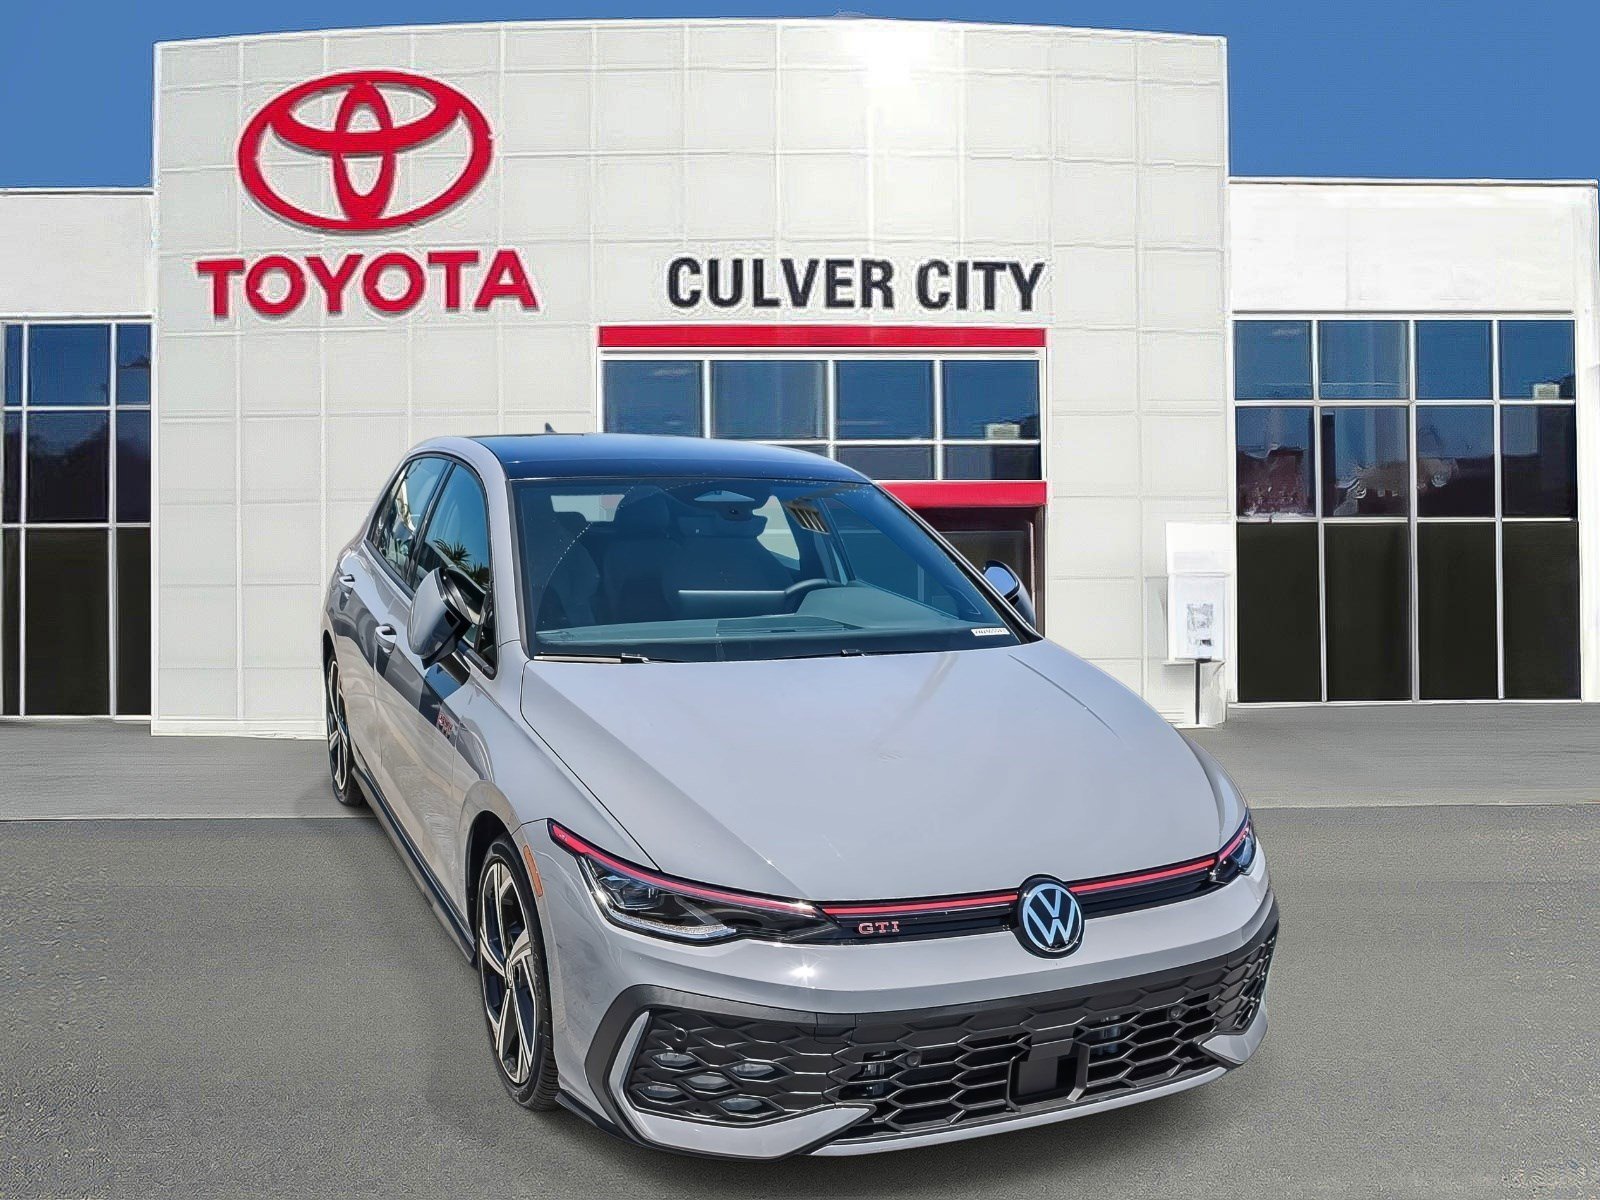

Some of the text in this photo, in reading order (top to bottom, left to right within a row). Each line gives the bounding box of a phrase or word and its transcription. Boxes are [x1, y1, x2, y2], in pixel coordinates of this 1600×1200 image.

[195, 249, 540, 319] TOYOTA
[667, 256, 1045, 311] CULVER CITY
[858, 920, 900, 935] GTI
[1026, 887, 1079, 949] VW
